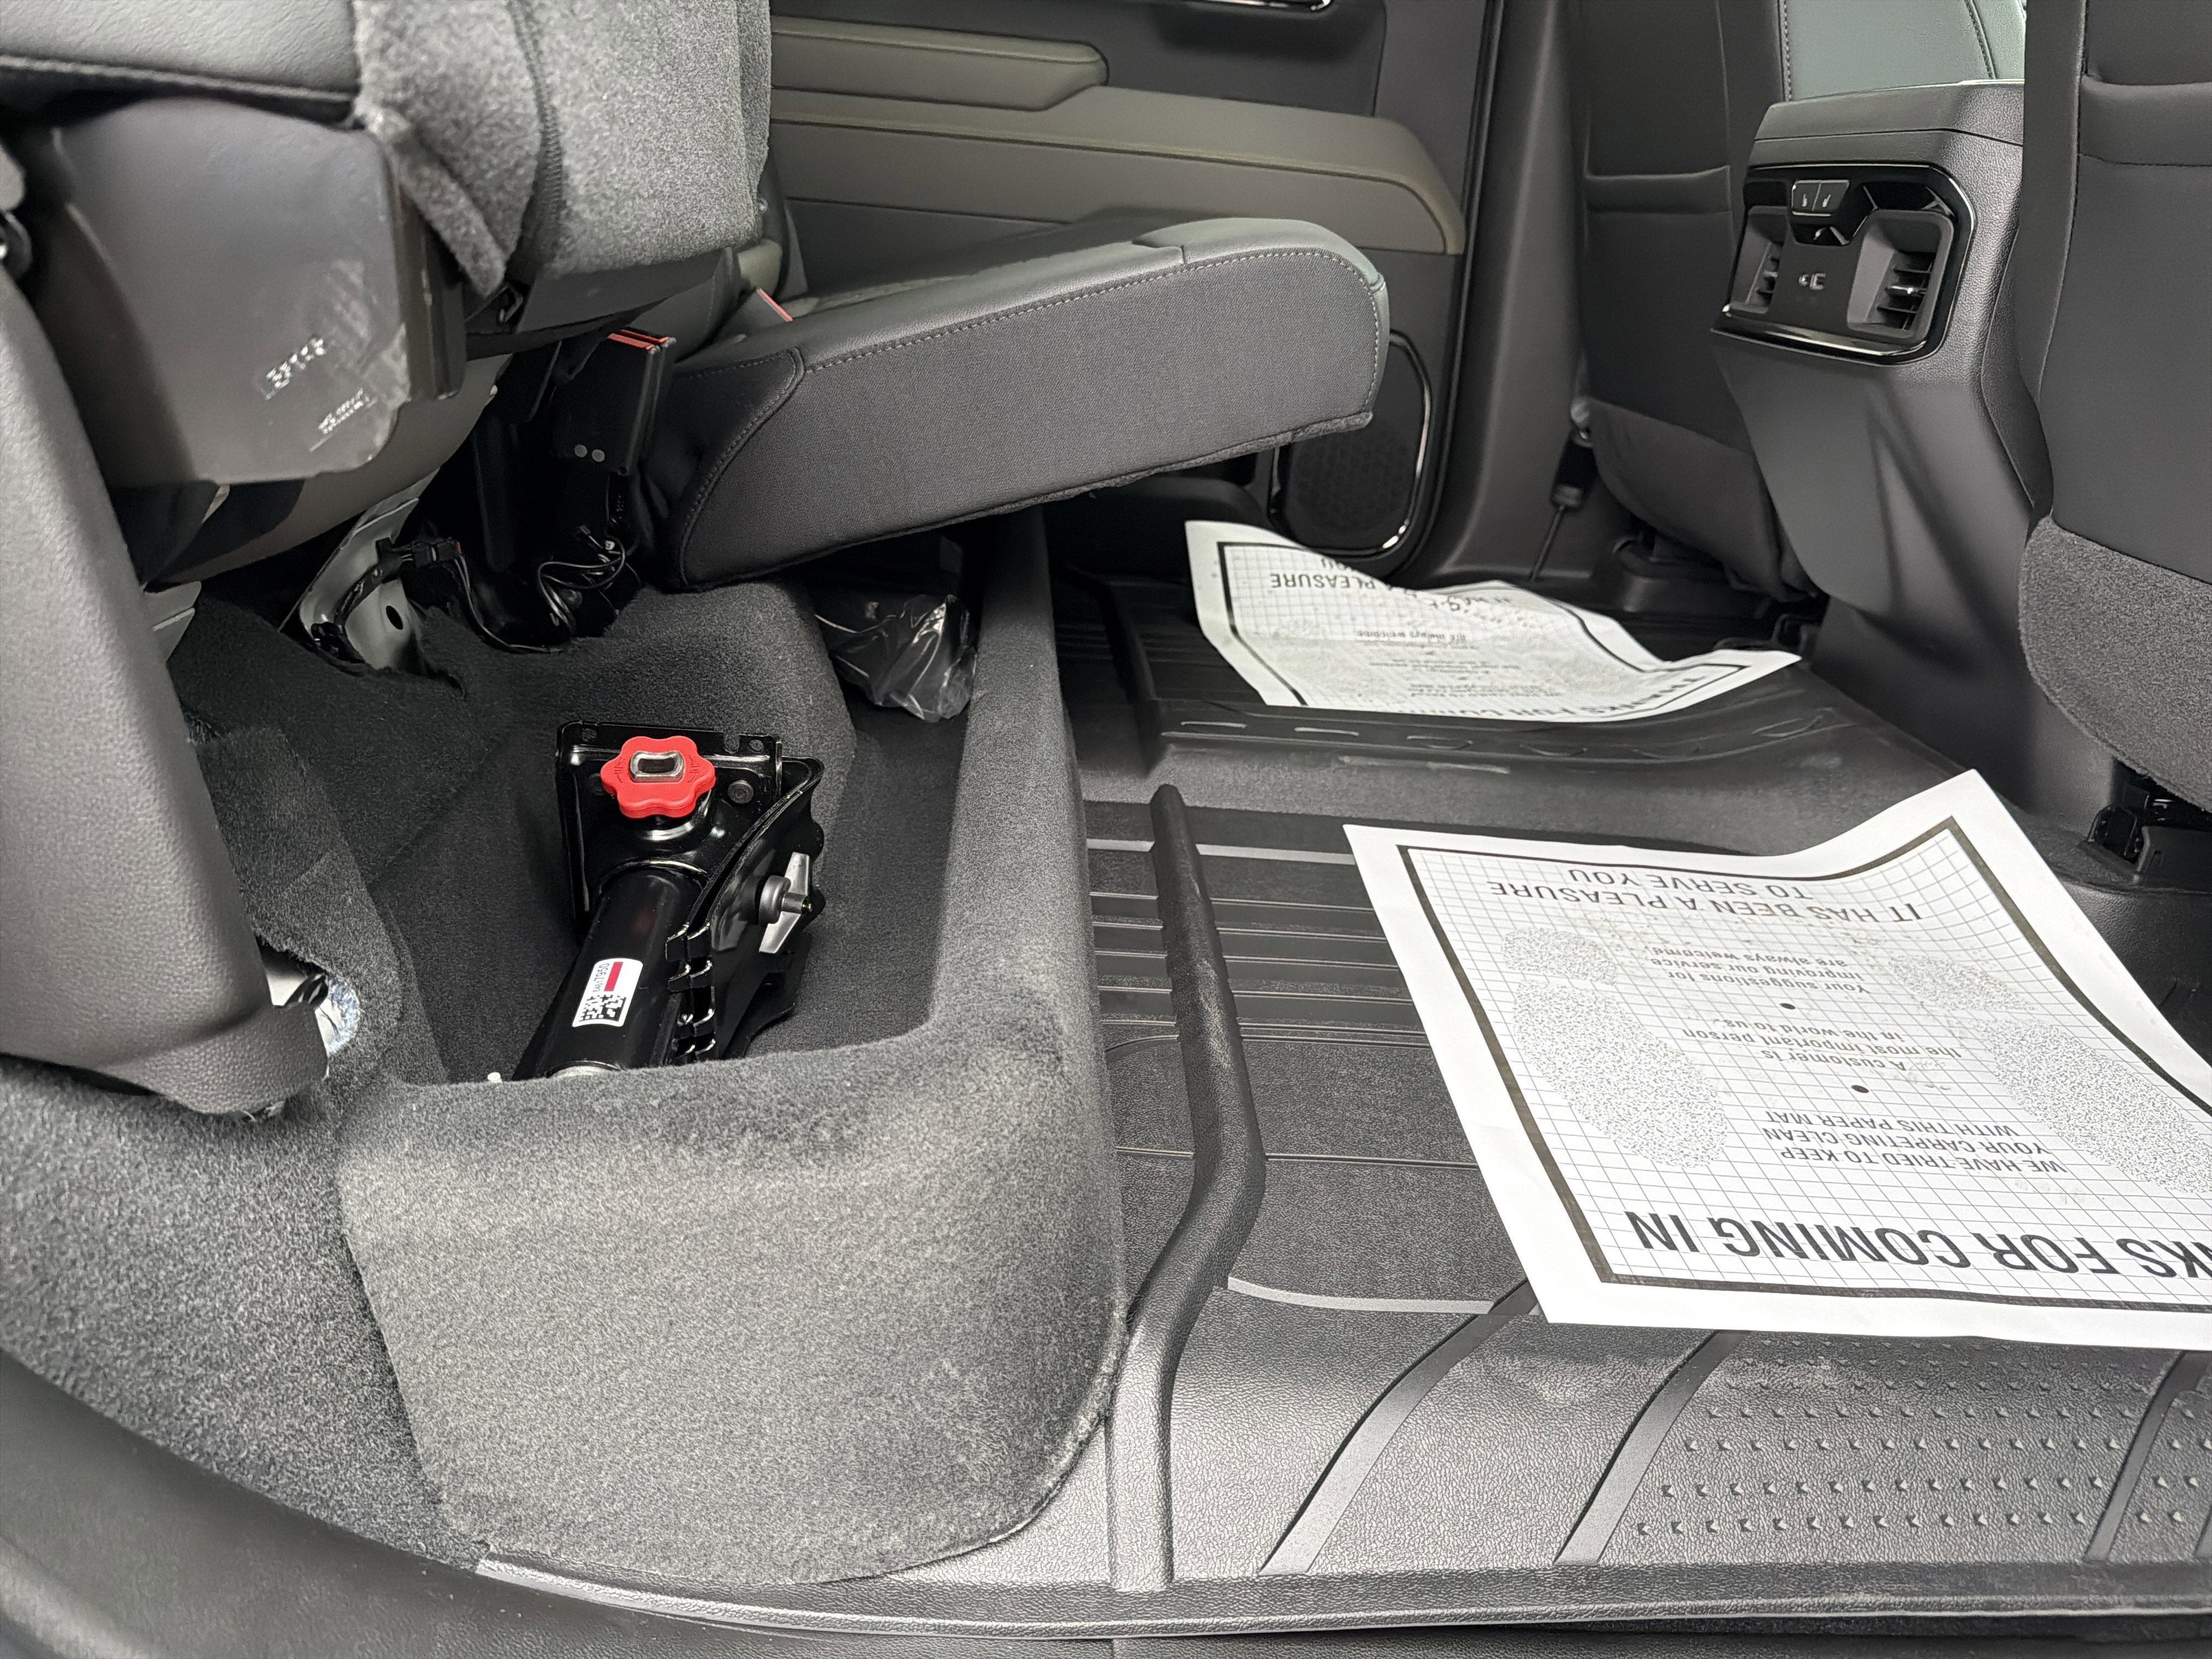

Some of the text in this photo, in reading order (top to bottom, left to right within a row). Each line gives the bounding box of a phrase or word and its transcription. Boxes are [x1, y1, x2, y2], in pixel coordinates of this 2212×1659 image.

[1269, 573, 1376, 589] PLEASURE
[1567, 869, 1813, 900] TO SERVE YOU
[1486, 881, 1923, 923] IT HAS BEEN A PLEASURE
[1650, 958, 1865, 982] improving our service
[1742, 952, 1811, 966] always
[1815, 958, 1847, 967] are
[1667, 971, 1871, 994] Your suggestions for
[1753, 1022, 1778, 1032] to
[1779, 1024, 1839, 1037] world
[1842, 1030, 1878, 1041] the
[1880, 1032, 1905, 1042] in
[1681, 1029, 1962, 1058] the most important person
[1760, 1049, 1906, 1071] A customer is
[1764, 1110, 2020, 1137] WITH THIS PAPER MAT
[1762, 1127, 2051, 1154] YOUR CARPETING CLEAN
[1780, 1147, 2067, 1173] WE HAVE TRIED TO KEEP
[1623, 1211, 1701, 1253] IN
[1707, 1216, 1971, 1269] COMING
[1970, 1232, 2120, 1276] FOR
